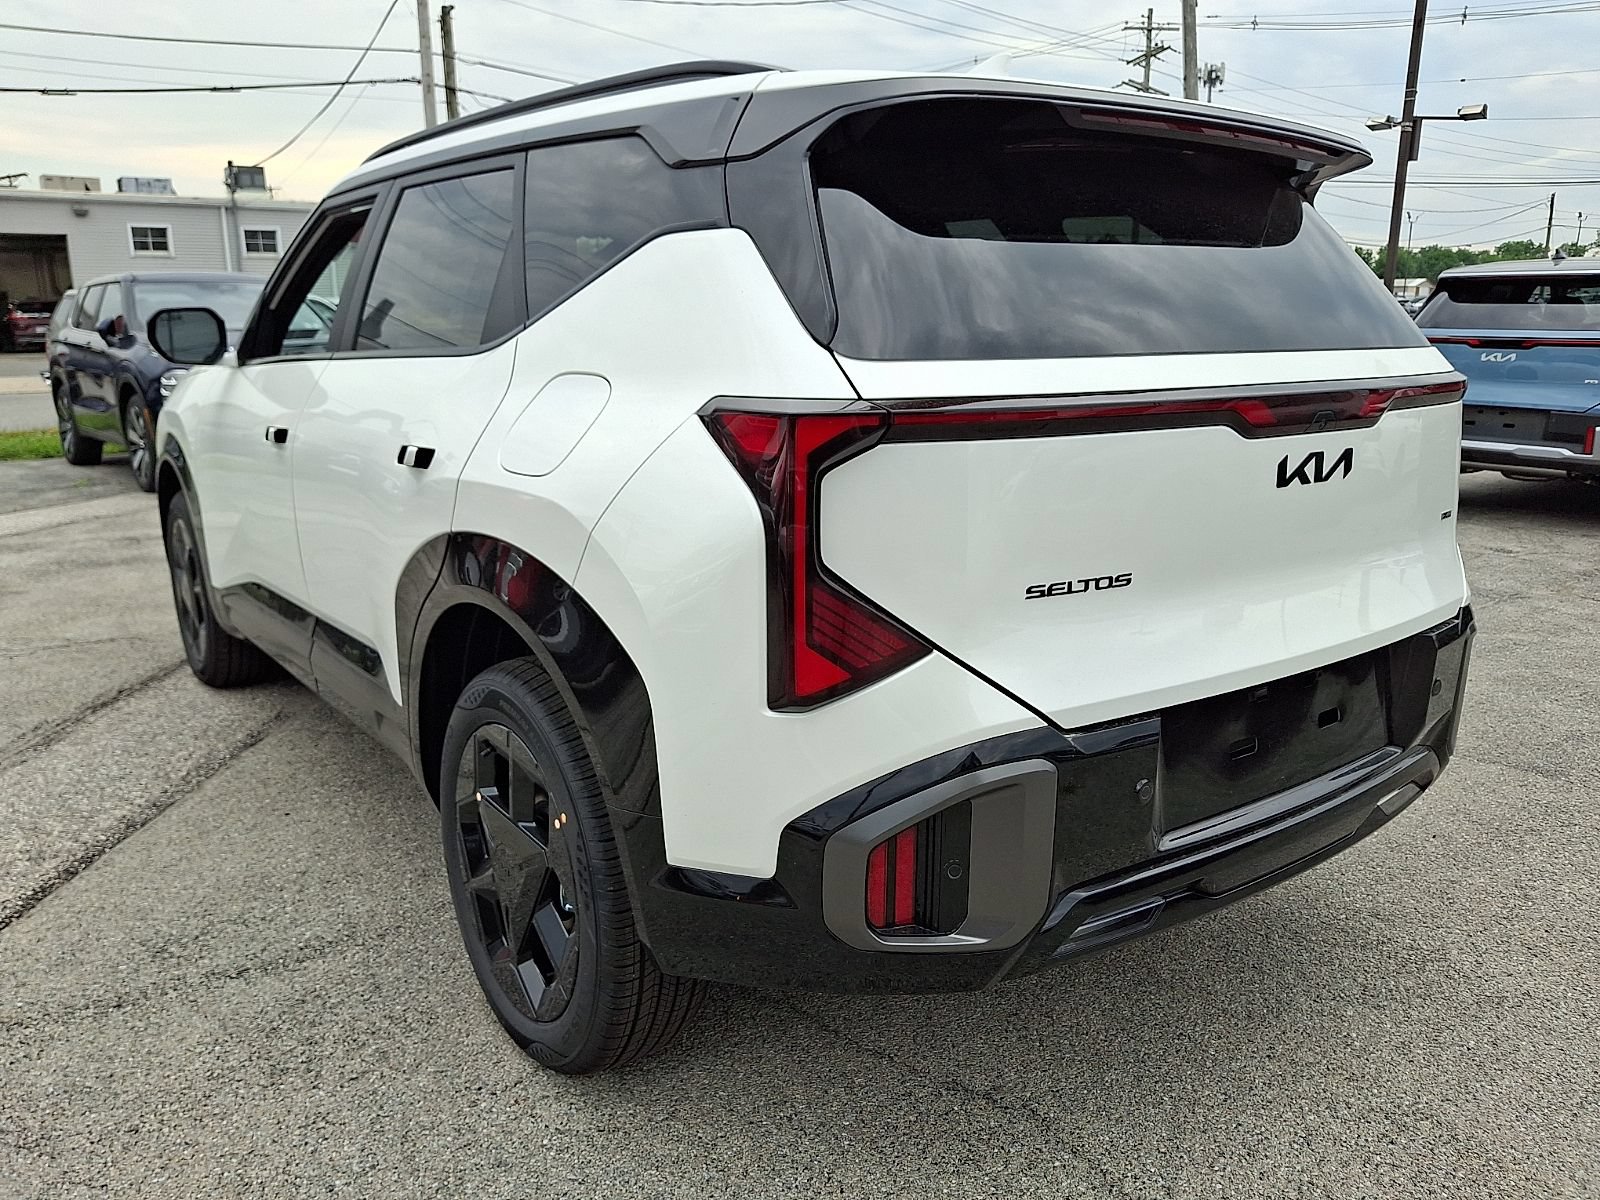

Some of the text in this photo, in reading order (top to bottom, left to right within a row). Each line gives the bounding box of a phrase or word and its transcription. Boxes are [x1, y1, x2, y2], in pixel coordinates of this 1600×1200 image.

[1480, 352, 1517, 362] KIA
[1276, 447, 1354, 489] KIA
[1024, 572, 1133, 600] SELTOS
